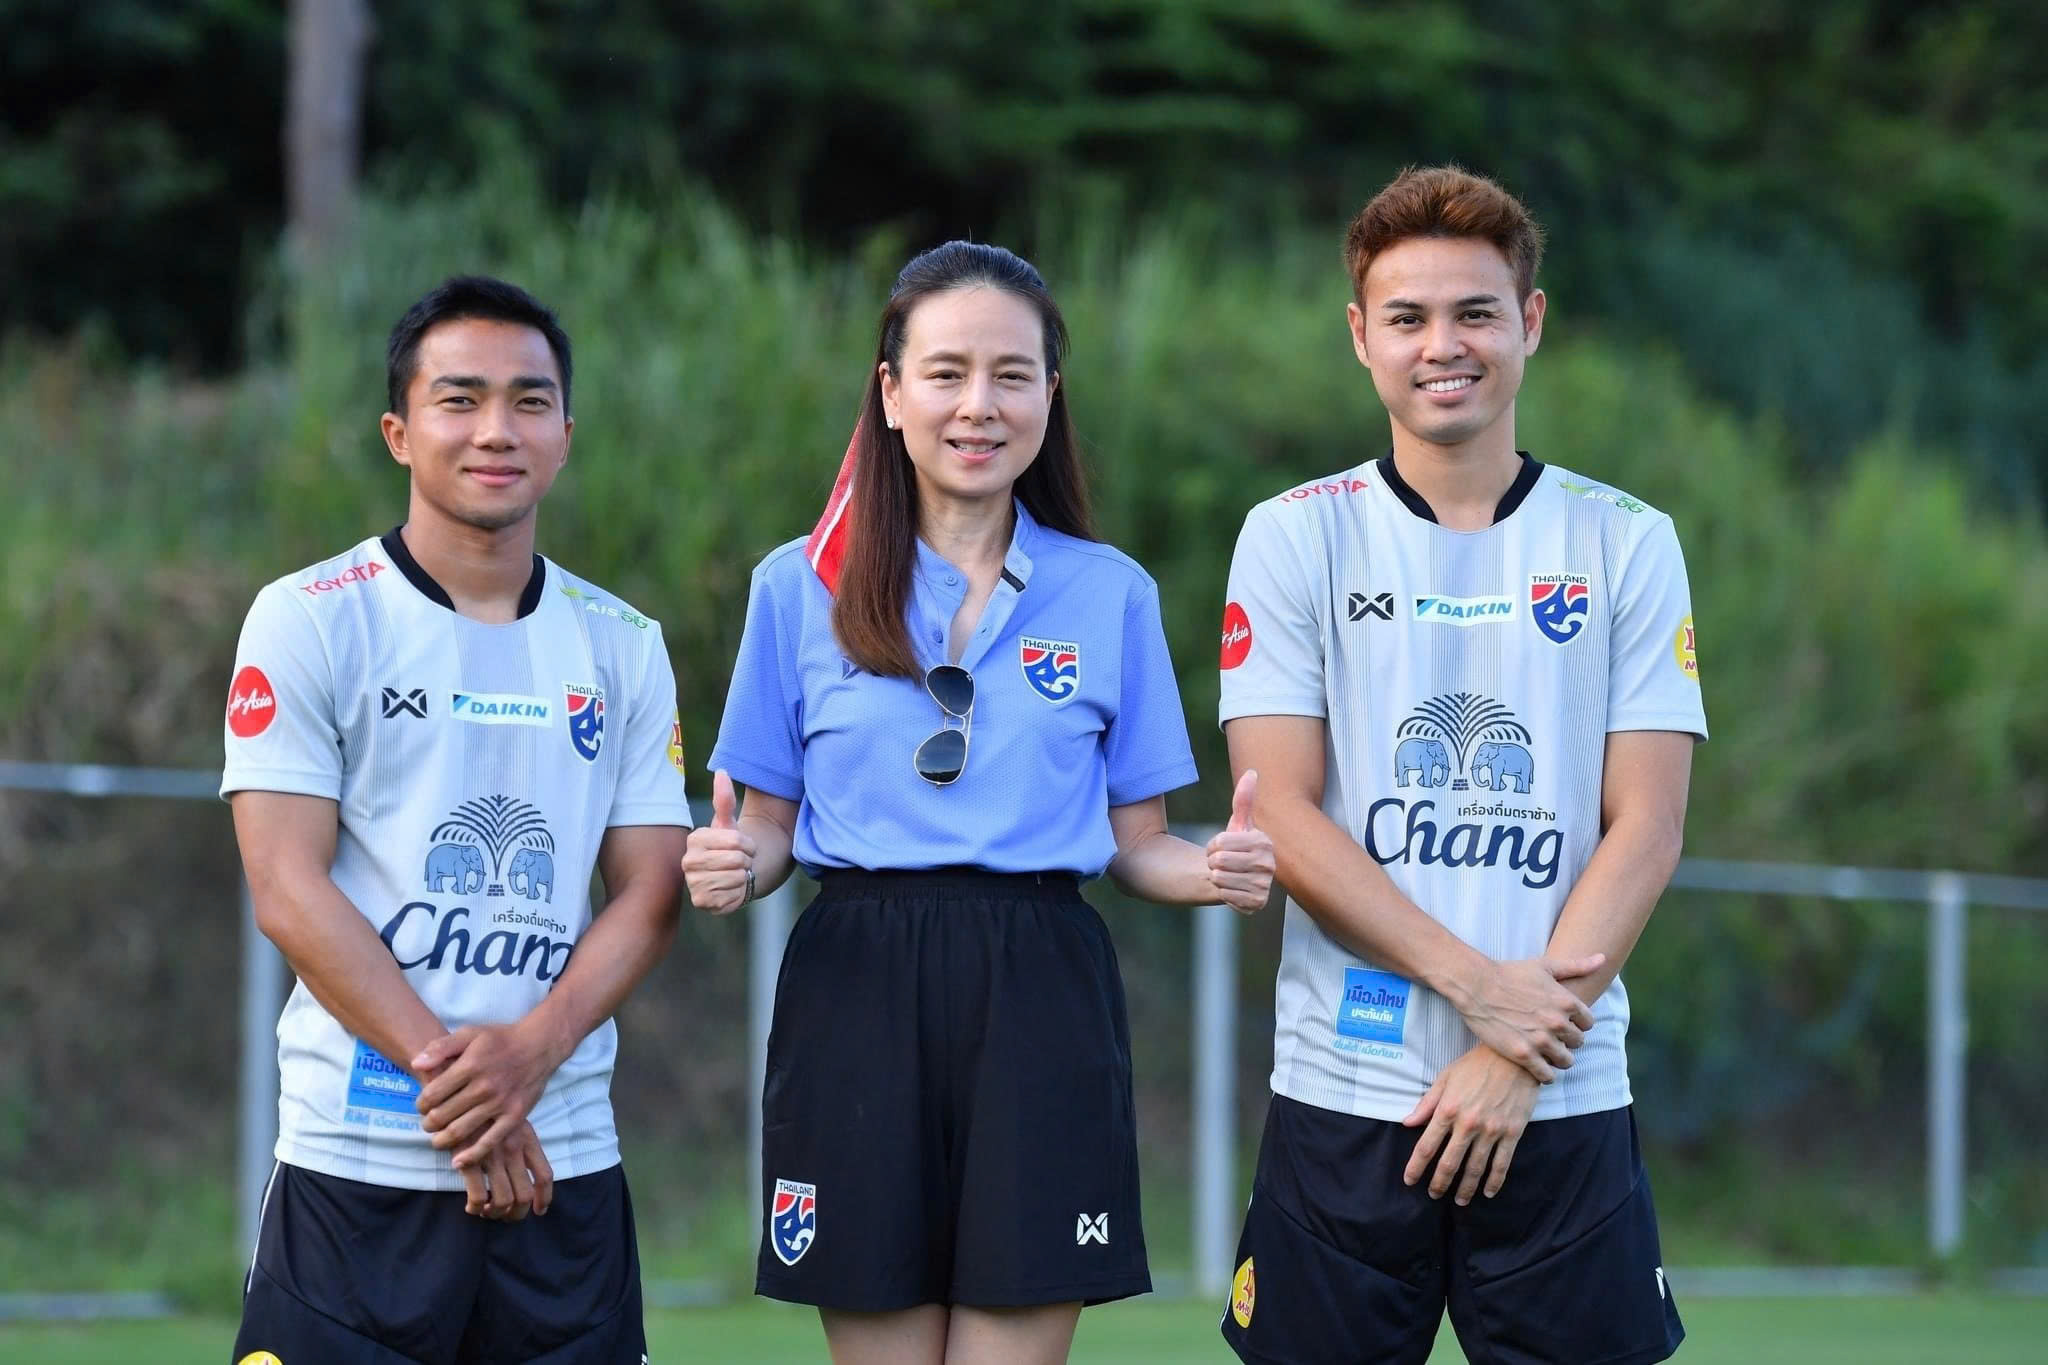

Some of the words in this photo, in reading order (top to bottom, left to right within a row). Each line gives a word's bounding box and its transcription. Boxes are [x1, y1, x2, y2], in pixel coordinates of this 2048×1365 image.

[1279, 479, 1369, 503] TOYOTA
[1584, 489, 1616, 502] AIS
[300, 561, 386, 595] TOYOTA
[1531, 574, 1587, 585] THAILAND
[586, 601, 618, 617] AIS
[1436, 601, 1512, 618] DAIKIN
[1022, 639, 1077, 653] THAILAND
[470, 701, 548, 718] DAIKIN
[1458, 800, 1556, 821] เครื่องดื่มตราช้าง
[1364, 797, 1564, 889] Chang
[1345, 985, 1405, 1009] เมืองไทย
[778, 1182, 815, 1197] THAILAND
